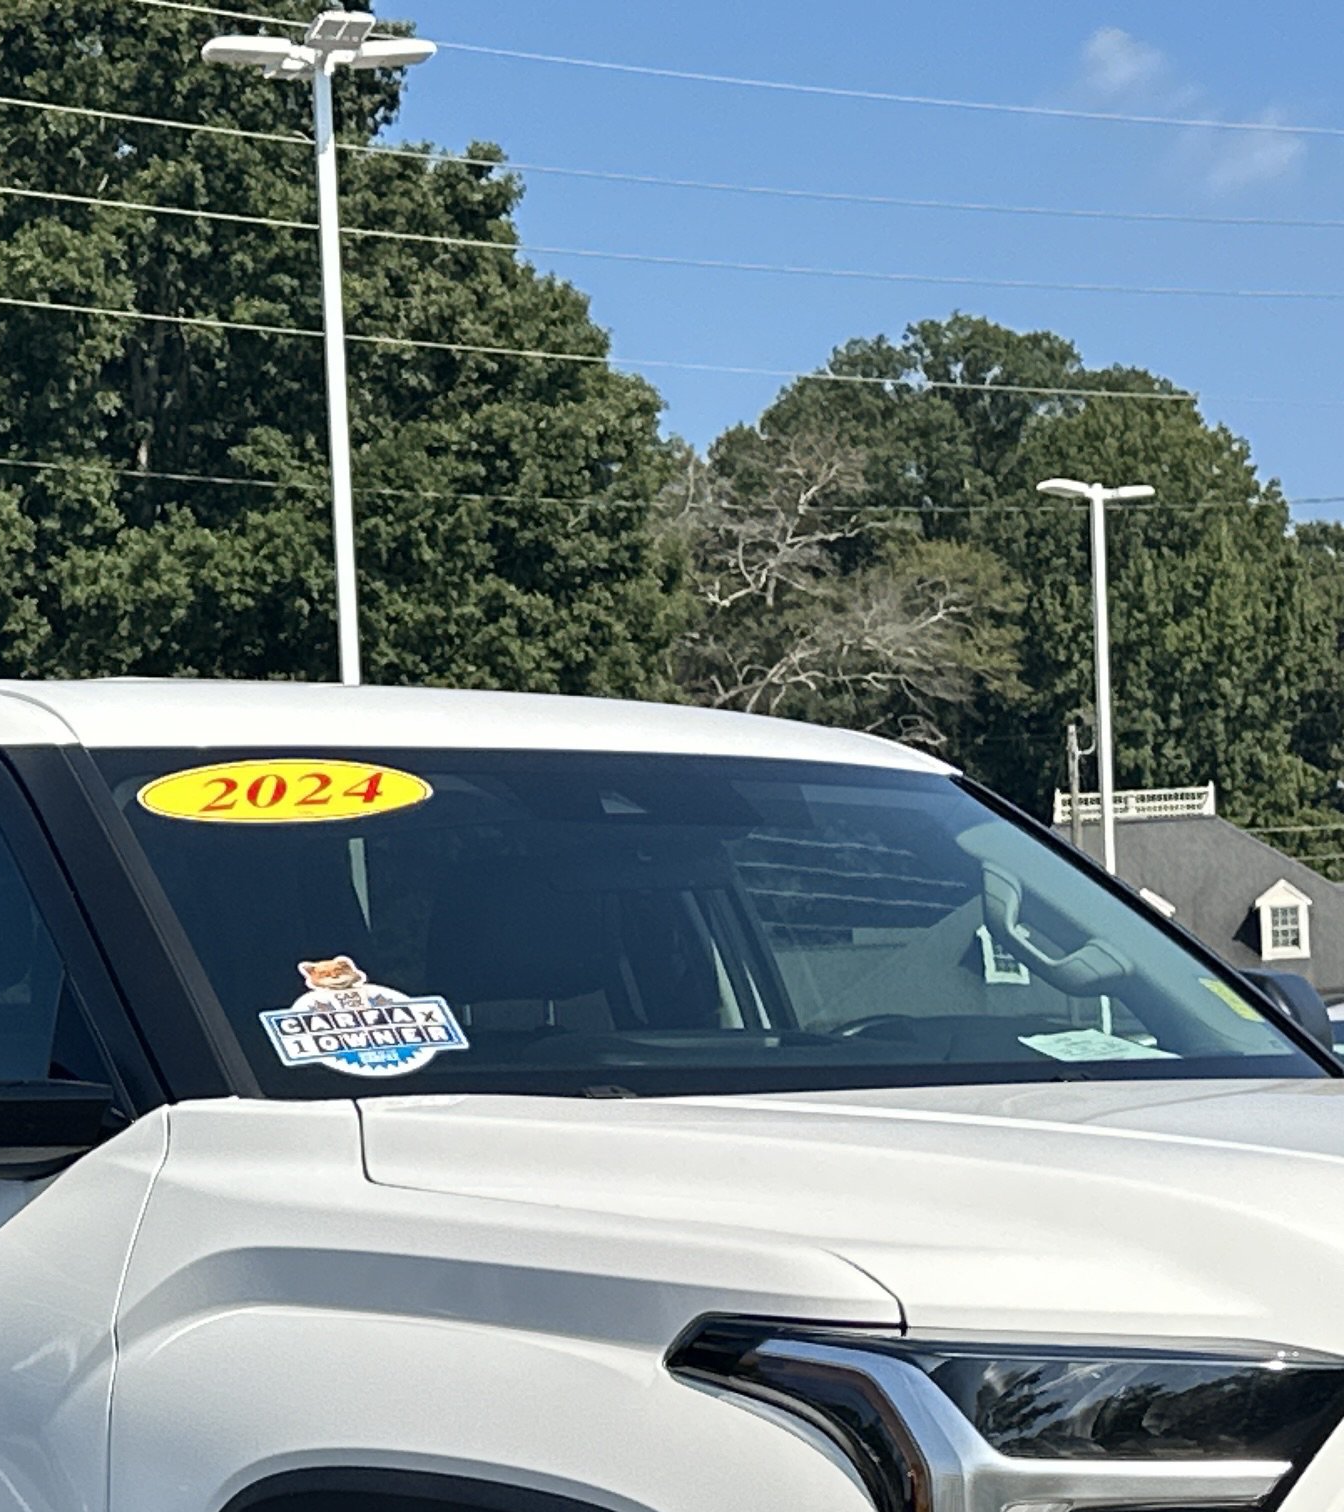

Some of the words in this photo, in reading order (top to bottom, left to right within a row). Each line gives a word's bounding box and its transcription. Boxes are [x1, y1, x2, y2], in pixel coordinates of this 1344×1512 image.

[199, 772, 384, 813] 2024
[276, 1006, 440, 1035] CARFAX
[291, 1039, 309, 1055] 1
[315, 1024, 454, 1052] OWNER
